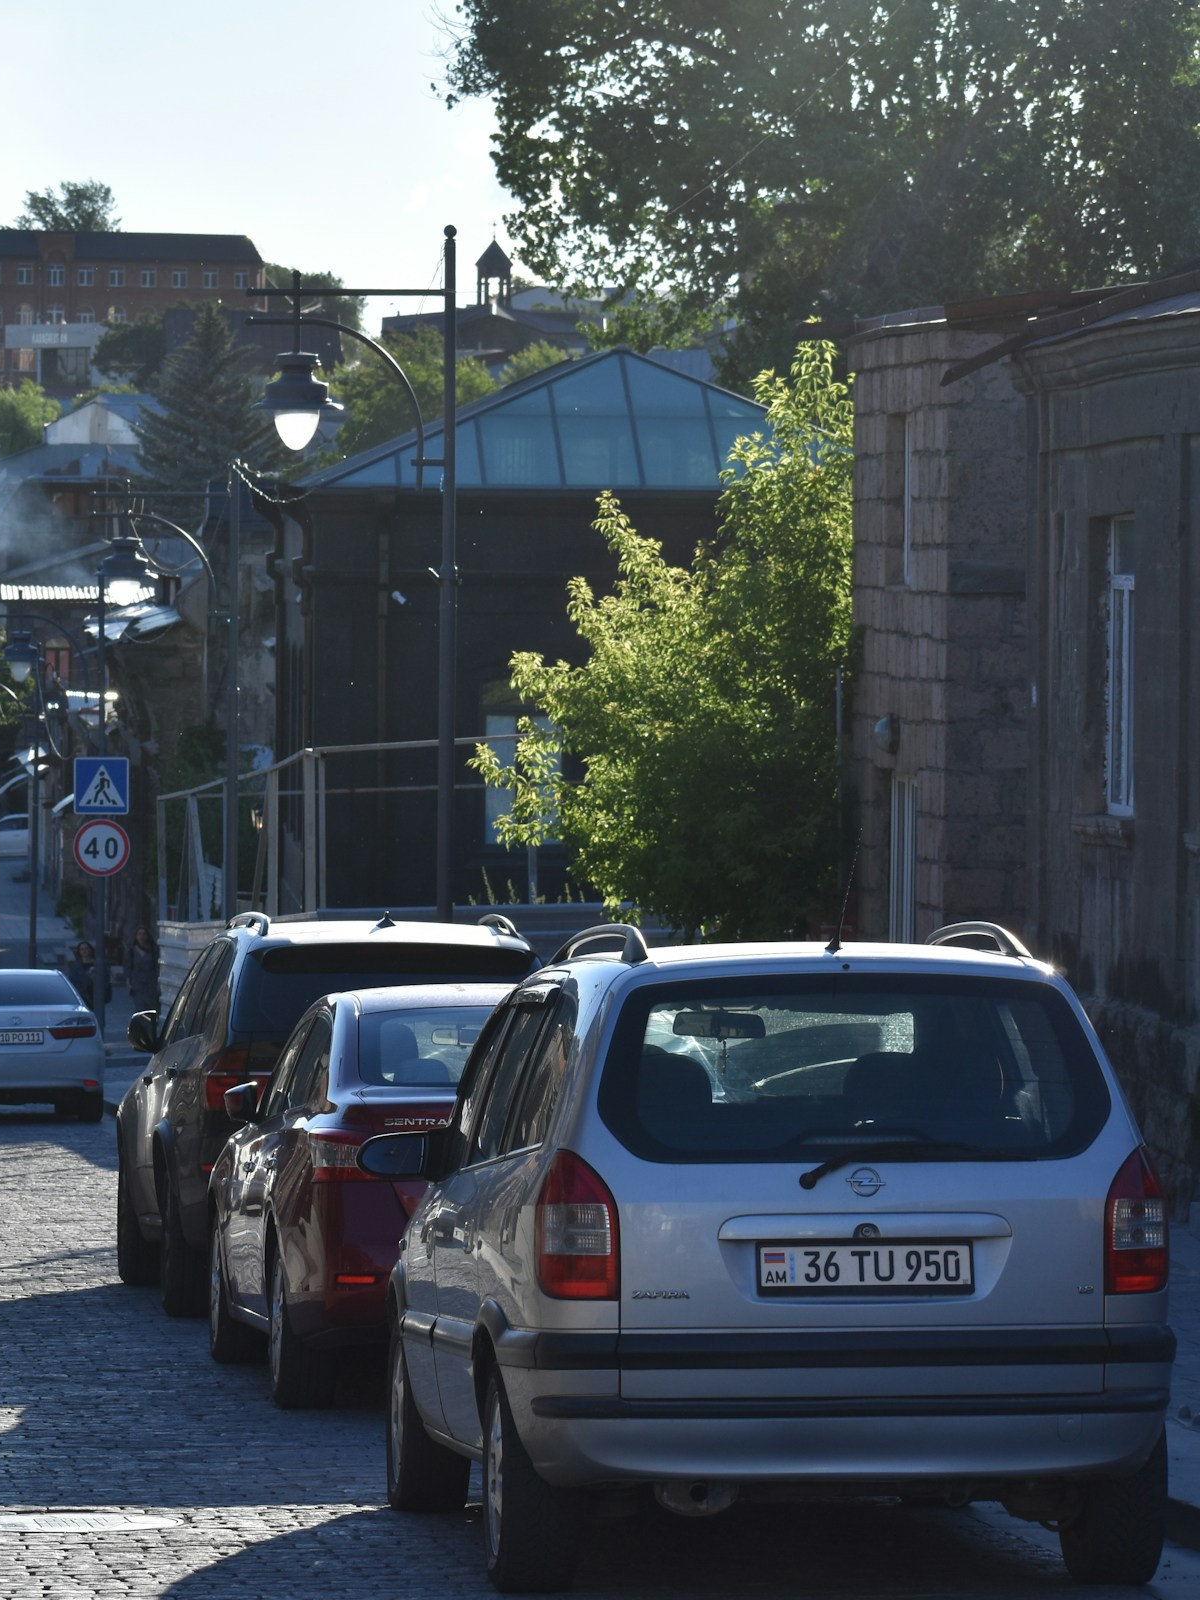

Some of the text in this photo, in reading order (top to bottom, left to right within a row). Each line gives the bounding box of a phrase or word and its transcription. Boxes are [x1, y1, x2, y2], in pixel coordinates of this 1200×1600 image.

[84, 837, 118, 859] 40
[25, 1033, 40, 1042] 111
[384, 1118, 448, 1126] SENTRA
[803, 1251, 840, 1283] 36
[850, 1250, 895, 1282] TU
[905, 1250, 961, 1282] 950
[765, 1271, 787, 1284] AM
[632, 1290, 690, 1300] ZAFIRA
